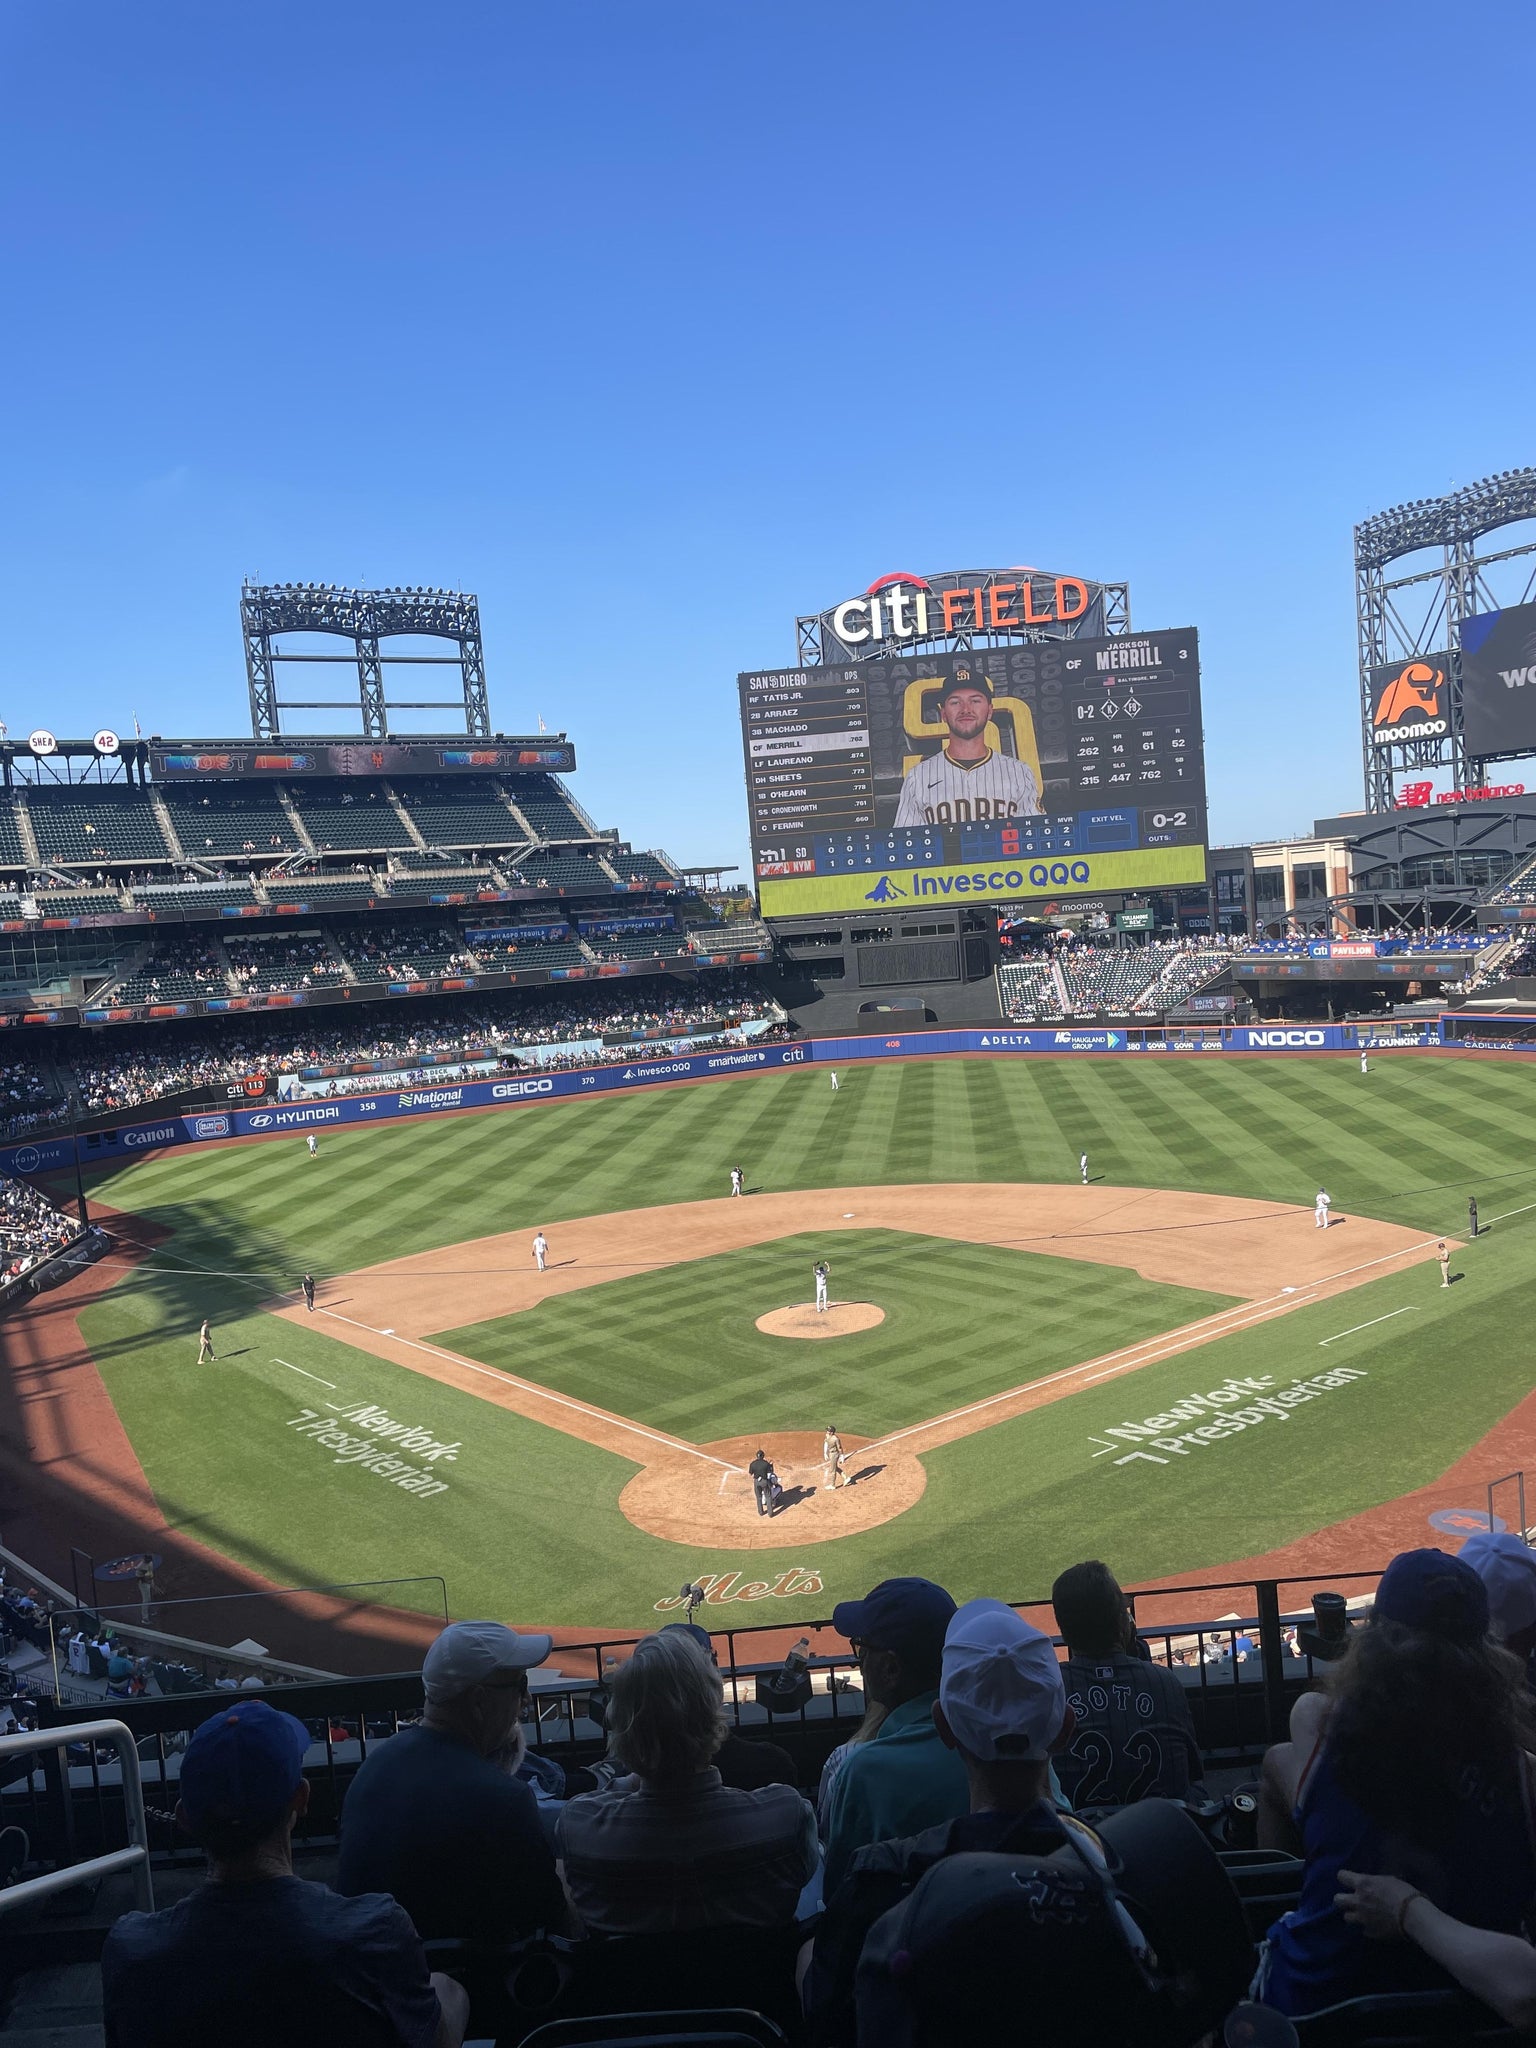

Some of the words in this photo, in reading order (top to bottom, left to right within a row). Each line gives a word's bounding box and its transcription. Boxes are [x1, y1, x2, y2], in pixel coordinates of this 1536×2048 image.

[833, 583, 928, 642] citi
[943, 577, 1088, 632] FIELD
[1106, 640, 1150, 650] JACKSON
[1096, 646, 1162, 671] MERRILL
[1178, 649, 1188, 659] 3
[1066, 659, 1081, 670] CF
[844, 670, 858, 680] OPS
[749, 676, 768, 690] SAN
[779, 673, 807, 687] DIEGO
[1129, 686, 1134, 694] 4
[763, 693, 789, 702] TATIS
[764, 709, 798, 718] ARRAEZ
[1077, 704, 1095, 719] 0-2
[1107, 705, 1113, 714] K
[765, 724, 808, 734] MACHADO
[1374, 719, 1447, 744] moomoo
[32, 737, 53, 747] SHEA
[98, 736, 114, 748] 42
[766, 741, 803, 750] MERRILL
[1077, 746, 1100, 757] .262
[1112, 744, 1124, 753] 14
[1142, 742, 1155, 751] 61
[1171, 739, 1186, 748] 52
[767, 756, 813, 766] LAUREANO
[769, 773, 802, 782] SHEETS
[1080, 775, 1100, 785] .315
[1108, 773, 1132, 783] .447
[1139, 770, 1161, 780] .762
[1177, 768, 1183, 776] 1
[770, 789, 807, 798] O'HEARN
[1436, 788, 1462, 804] new
[1465, 783, 1525, 801] balance
[772, 804, 817, 814] CRONENWORTH
[1152, 812, 1187, 828] 0-2
[773, 821, 804, 831] FERMIN
[1148, 834, 1171, 842] OUTS:
[795, 847, 807, 858] SD
[793, 860, 812, 872] NYM
[912, 870, 1023, 897] Invesco
[1029, 861, 1090, 888] QQQ
[1061, 901, 1104, 912] moomoo
[1312, 942, 1328, 956] citi
[1332, 945, 1372, 956] PAVILION
[993, 1036, 1031, 1045] DELTA
[1054, 1031, 1072, 1043] HG
[1248, 1031, 1324, 1046] NOCO
[1427, 1037, 1440, 1045] 370
[885, 1040, 900, 1048] 408
[1126, 1042, 1141, 1051] 380
[1464, 1040, 1514, 1050] CADILLAC
[708, 1052, 757, 1068] smartwater
[782, 1047, 804, 1062] citi
[637, 1065, 671, 1077] Invesco
[671, 1062, 691, 1074] QQQ
[248, 1081, 263, 1089] 113
[581, 1076, 595, 1085] 370
[227, 1083, 244, 1094] citi
[492, 1079, 553, 1098] GEICO
[413, 1088, 463, 1105] National
[360, 1102, 377, 1111] 358
[276, 1107, 339, 1124] HYUNDAI
[123, 1127, 175, 1146] Canon
[1149, 1367, 1368, 1455] Presbyterian
[296, 1417, 449, 1498] Presbyterian
[653, 1567, 824, 1611] Mets
[1066, 1684, 1154, 1721] SOTO
[1069, 1730, 1163, 1801] 22
